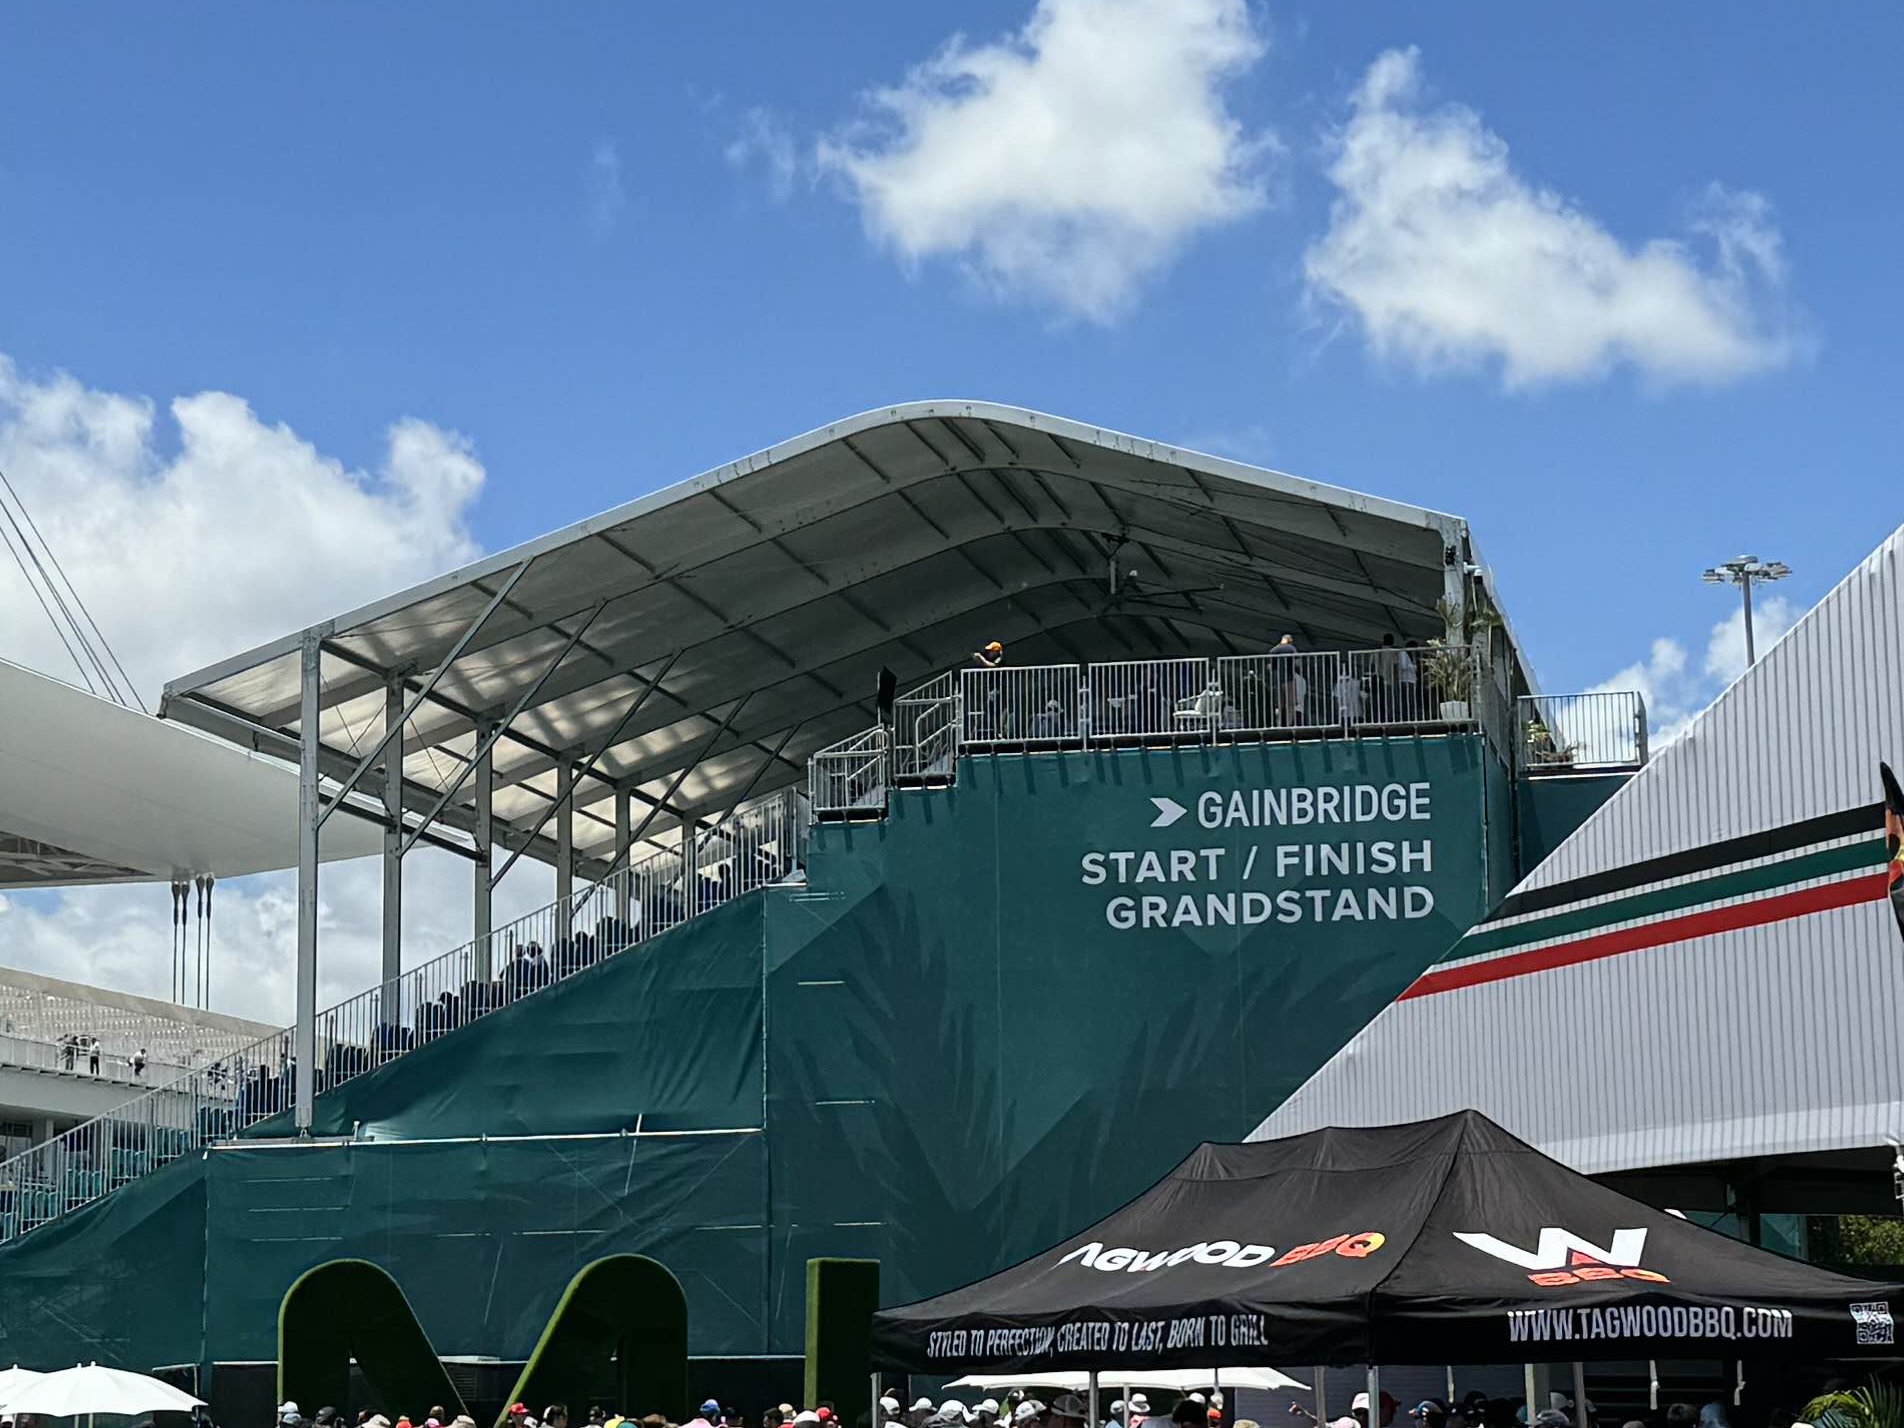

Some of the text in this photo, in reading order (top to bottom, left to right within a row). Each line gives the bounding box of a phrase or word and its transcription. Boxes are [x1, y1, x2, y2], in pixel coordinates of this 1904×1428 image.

[1197, 782, 1431, 829] GAINBRIDGE
[1081, 847, 1226, 885] START
[1276, 839, 1432, 878] FINISH
[1106, 885, 1435, 930] GRANDSTAND
[1049, 1241, 1276, 1272] AGWOD
[927, 1330, 966, 1357] STYLED
[970, 1329, 985, 1356] TO
[987, 1326, 1055, 1357] PERFECTION,
[1057, 1322, 1109, 1352] CREATED
[1113, 1321, 1129, 1351] TO
[1131, 1320, 1166, 1354] LAST,
[1167, 1317, 1205, 1348] BORN
[1209, 1315, 1227, 1347] TO
[1506, 1306, 1794, 1342] WWW.TAGWOODBBQ.COM
